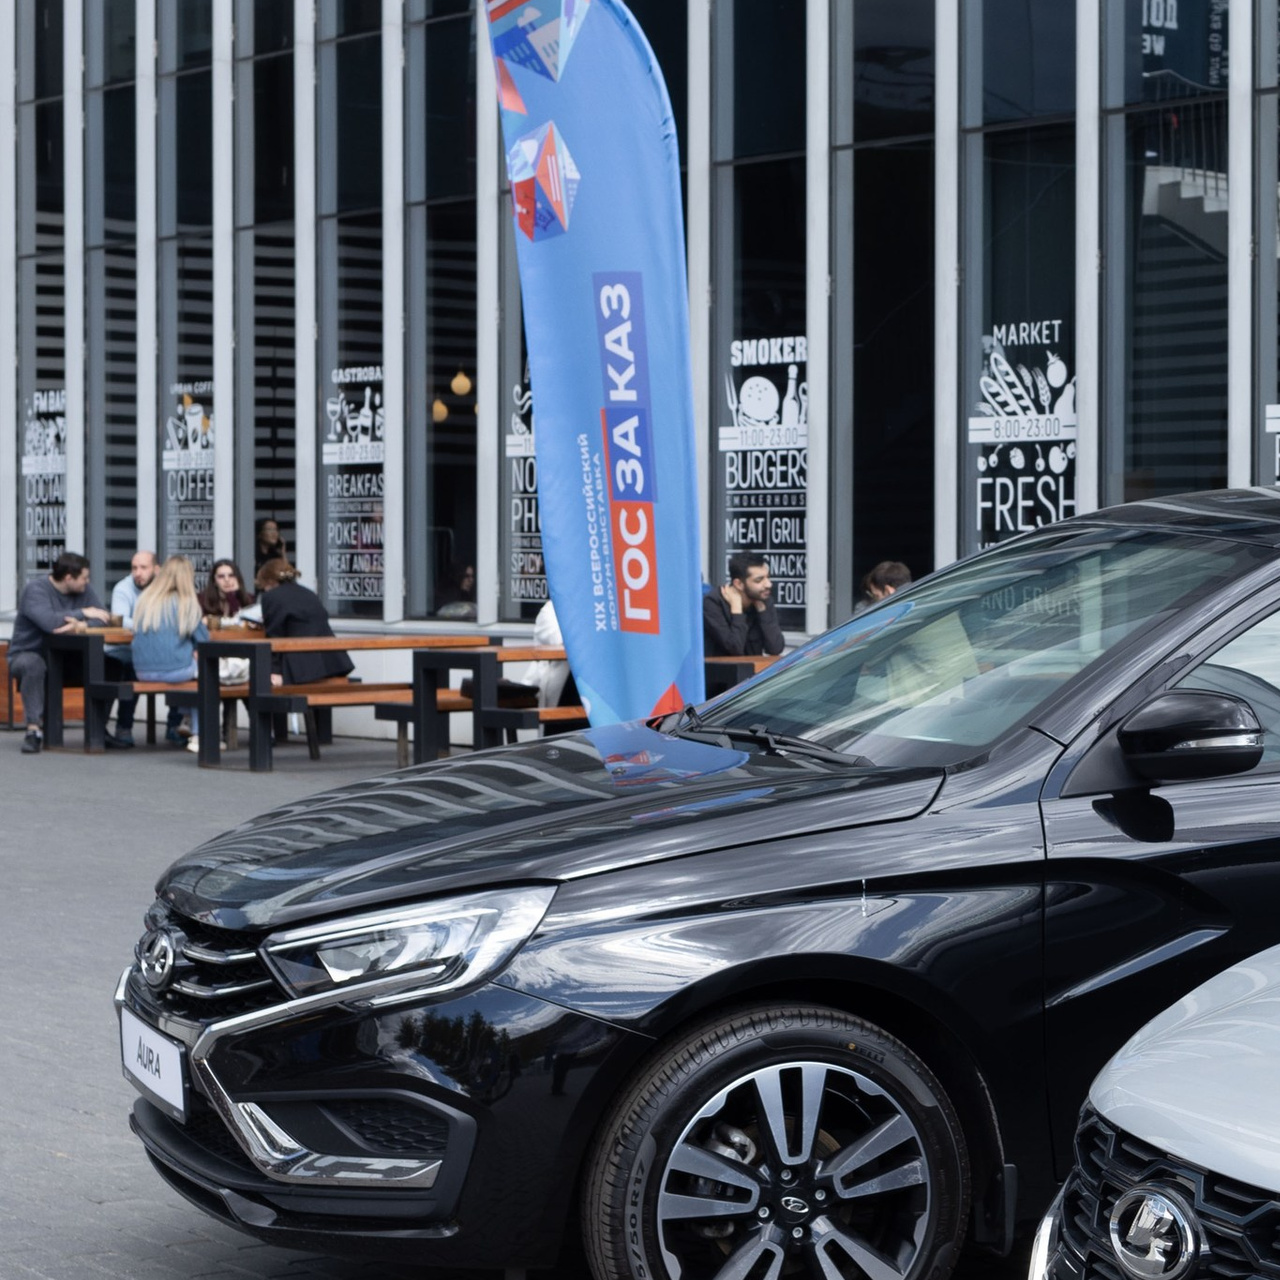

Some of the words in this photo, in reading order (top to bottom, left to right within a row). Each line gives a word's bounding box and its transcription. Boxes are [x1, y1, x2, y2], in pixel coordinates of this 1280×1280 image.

[993, 319, 1062, 347] MARKET
[730, 335, 807, 367] SMOKER
[331, 365, 384, 384] GASTROBA
[740, 427, 799, 447] 11:00-23:00
[993, 417, 1061, 439] 8:00-23:00
[725, 449, 807, 489] BURGERS
[511, 498, 542, 533] PH
[577, 433, 605, 597] ВСЕРОССИЙСКИЙ
[327, 521, 357, 545] POKE
[725, 516, 765, 544] MEAT
[511, 553, 542, 573] SPICY
[763, 554, 807, 577] NACK
[777, 582, 807, 604] FOO
[136, 1035, 161, 1079] AURA
